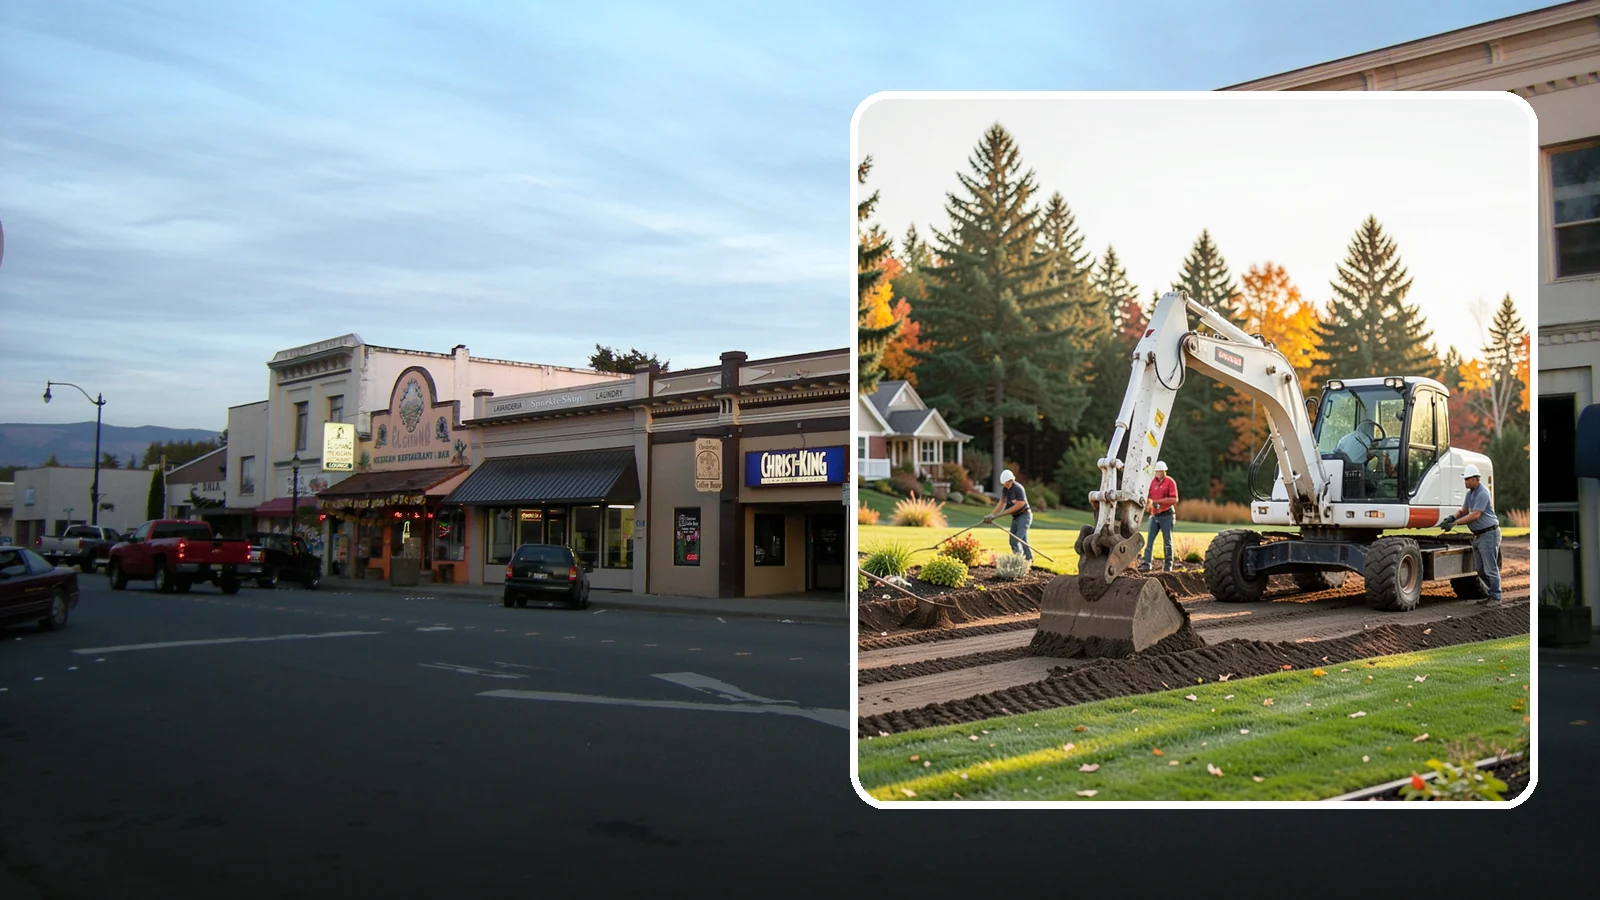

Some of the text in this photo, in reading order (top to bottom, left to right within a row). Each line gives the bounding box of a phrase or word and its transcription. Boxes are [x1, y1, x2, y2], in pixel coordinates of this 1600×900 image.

[530, 394, 582, 409] Sparkle Shop
[595, 389, 623, 400] LAUNDRY
[493, 402, 522, 413] LAVANDERIA
[392, 425, 402, 449] EL
[373, 455, 396, 464] MEXICAN
[397, 451, 433, 462] RESTAURANT
[438, 450, 450, 459] BAR
[761, 450, 827, 478] CHRIST KING
